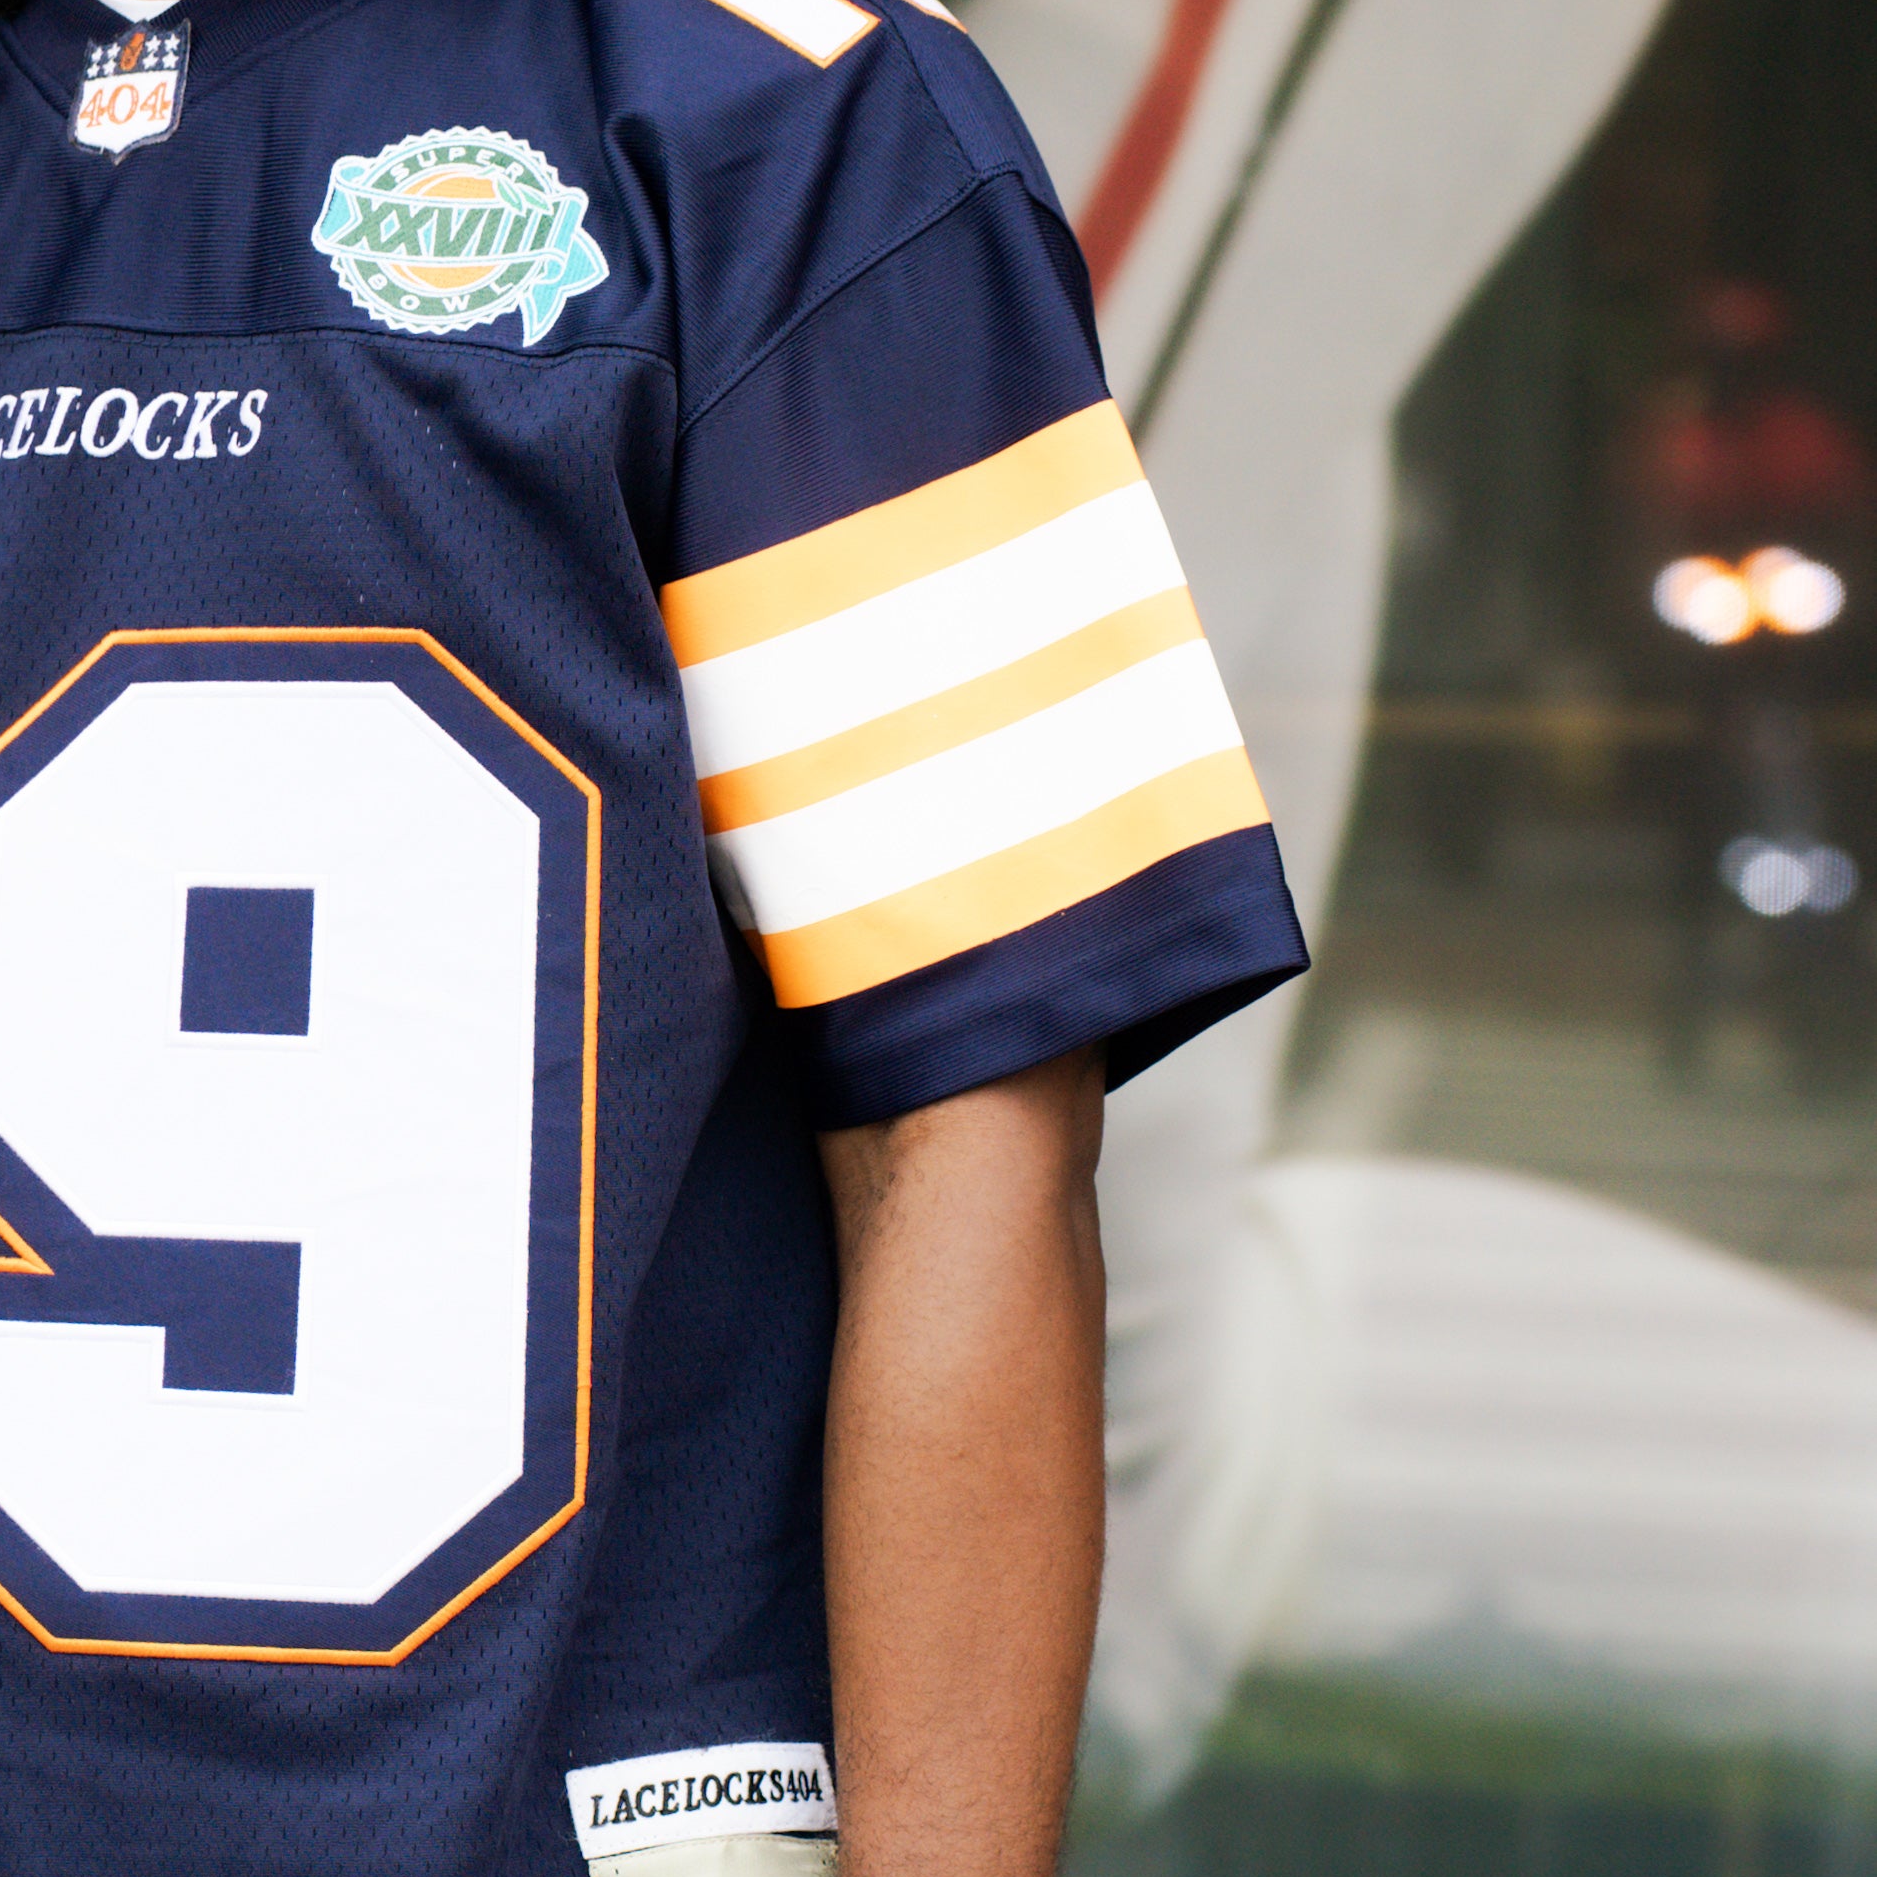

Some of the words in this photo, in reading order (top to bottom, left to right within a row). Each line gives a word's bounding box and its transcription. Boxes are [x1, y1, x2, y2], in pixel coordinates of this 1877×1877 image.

[79, 81, 172, 129] 404
[389, 146, 525, 184] SUPER
[333, 193, 563, 259] XXVIII
[367, 273, 514, 313] BOWL
[589, 1768, 825, 1828] LACELOCKS404
